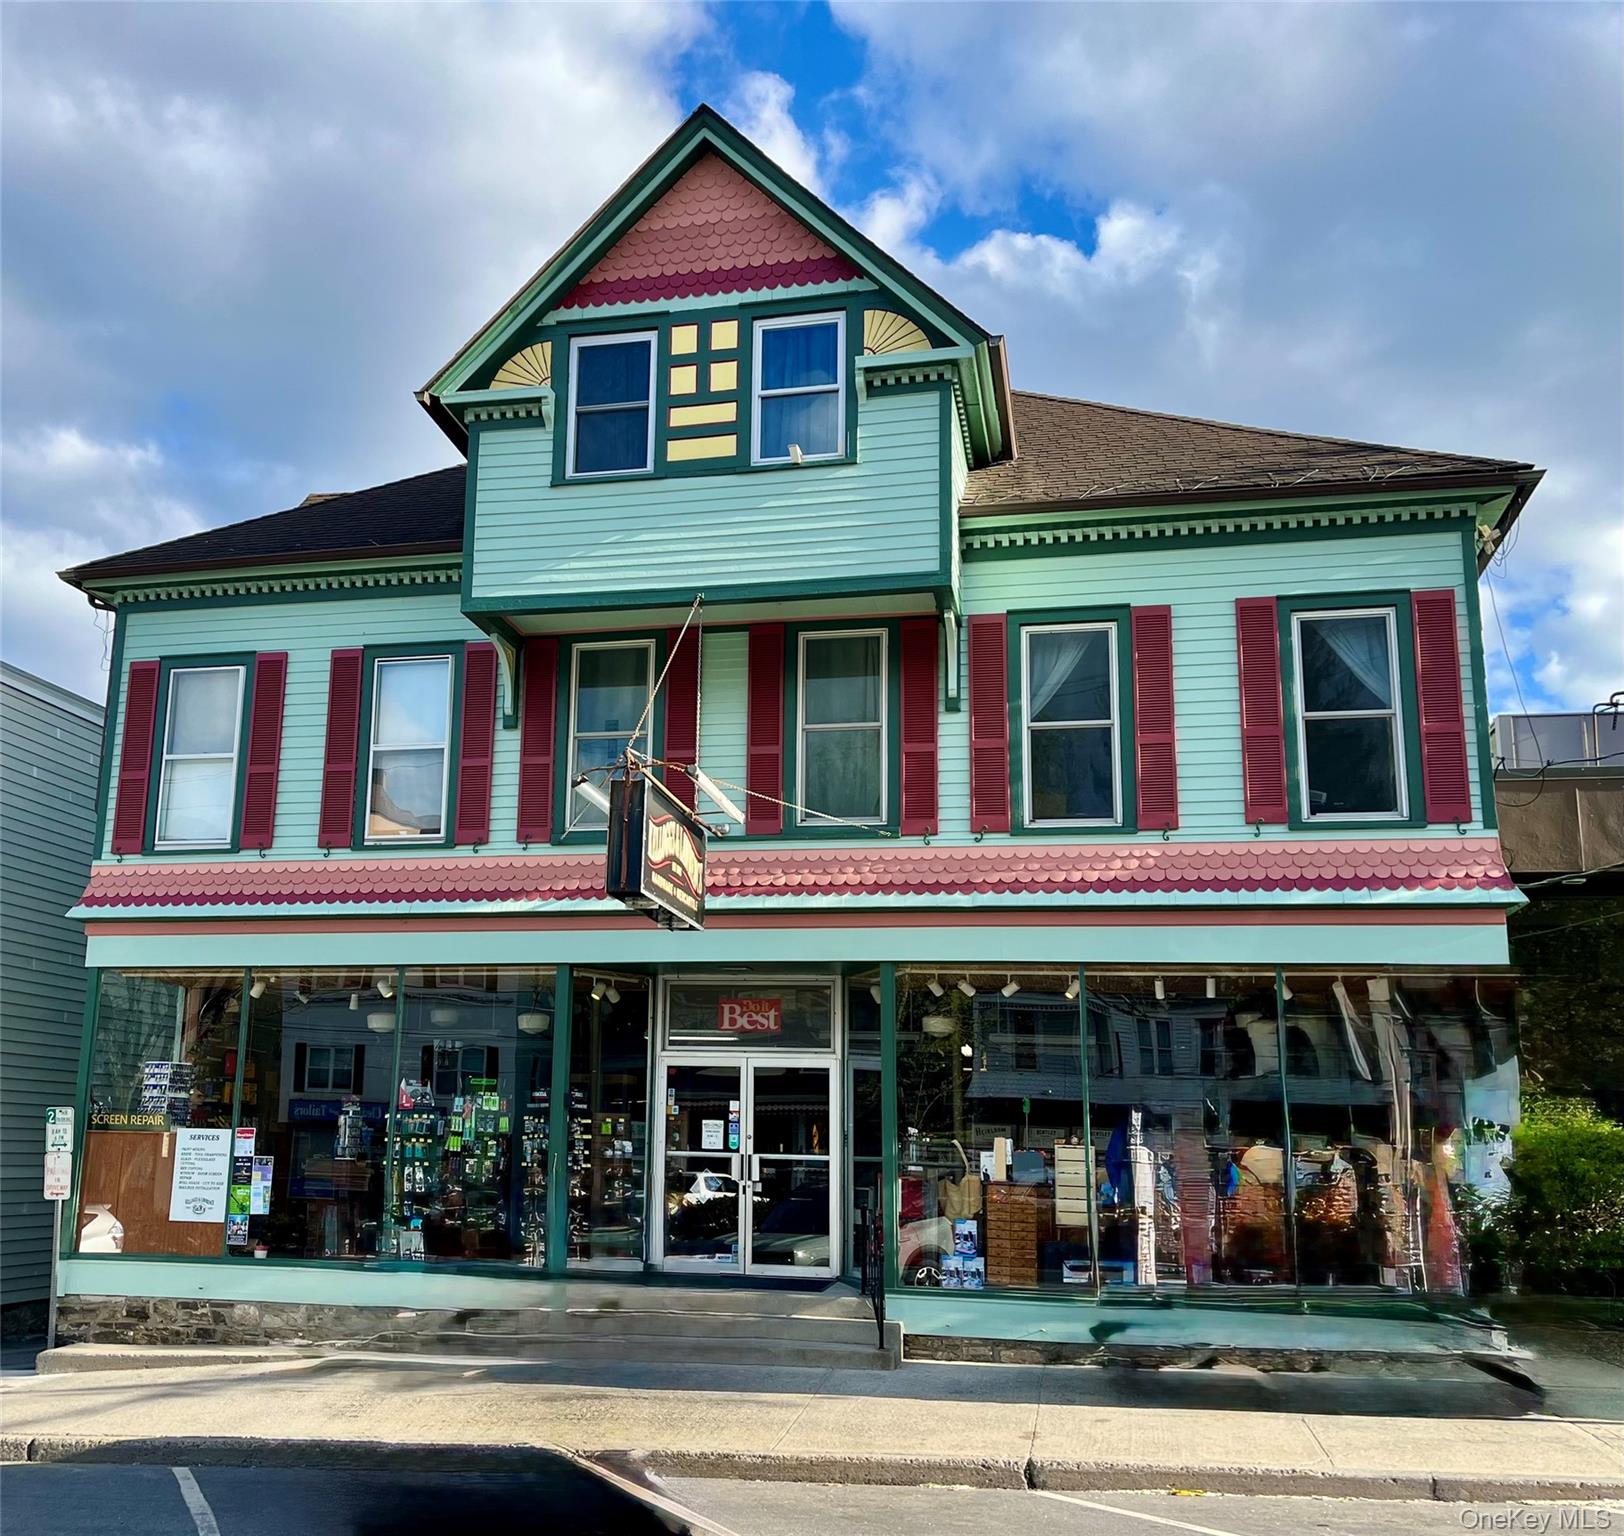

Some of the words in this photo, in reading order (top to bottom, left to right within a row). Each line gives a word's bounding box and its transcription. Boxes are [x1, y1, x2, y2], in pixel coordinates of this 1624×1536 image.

[720, 1004, 778, 1030] Best
[48, 1111, 55, 1123] 2
[91, 1114, 128, 1125] SCREEN
[130, 1114, 165, 1126] REPAIR
